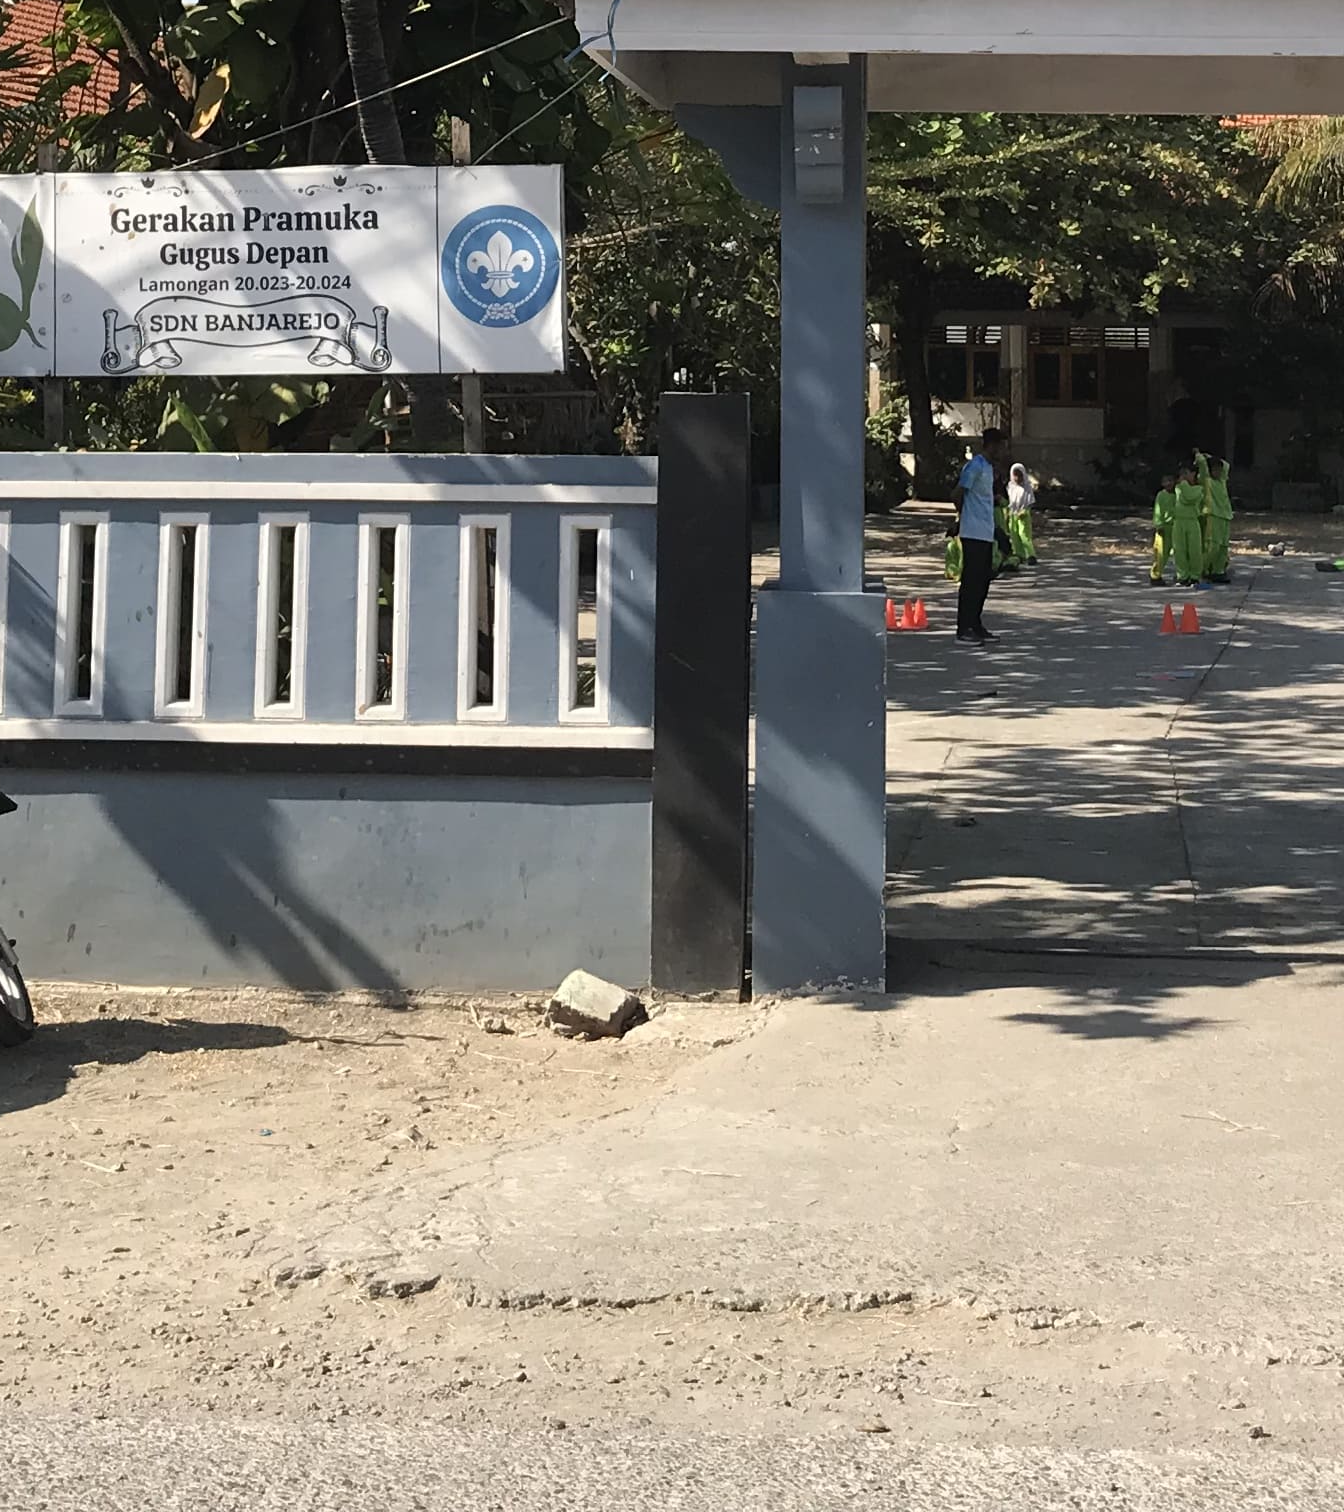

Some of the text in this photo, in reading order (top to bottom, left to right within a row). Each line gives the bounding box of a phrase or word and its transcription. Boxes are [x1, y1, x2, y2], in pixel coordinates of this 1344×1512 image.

[109, 203, 379, 234] Gerakan Pramuka
[159, 241, 329, 270] Gugus Depan
[139, 274, 351, 295] Lamongan 20.023-20.024
[149, 310, 341, 333] SDN BANJAREJO
